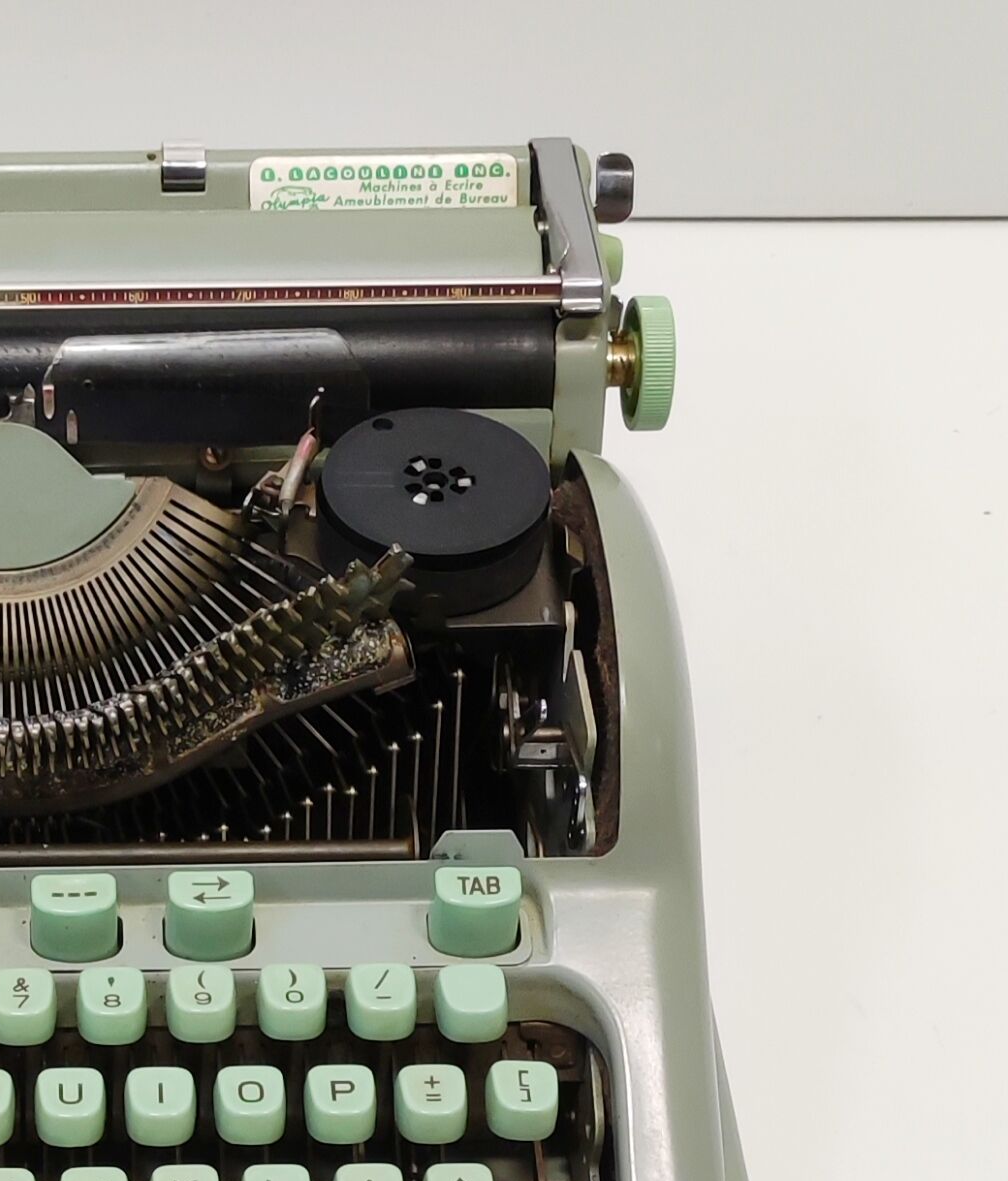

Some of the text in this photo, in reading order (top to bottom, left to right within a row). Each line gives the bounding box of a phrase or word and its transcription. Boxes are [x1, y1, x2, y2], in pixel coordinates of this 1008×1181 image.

[288, 164, 443, 181] LACOULINE
[454, 163, 511, 179] INC.
[359, 180, 484, 193] Machines à Ecrire
[333, 193, 509, 207] Ameublement de Bureau
[456, 875, 501, 896] TAB
[12, 977, 30, 993] &
[12, 994, 30, 1009] 7
[103, 993, 122, 1008] 8
[194, 991, 213, 1006] 9
[58, 1083, 83, 1105] U
[237, 1080, 265, 1103] O
[330, 1080, 356, 1102] P
